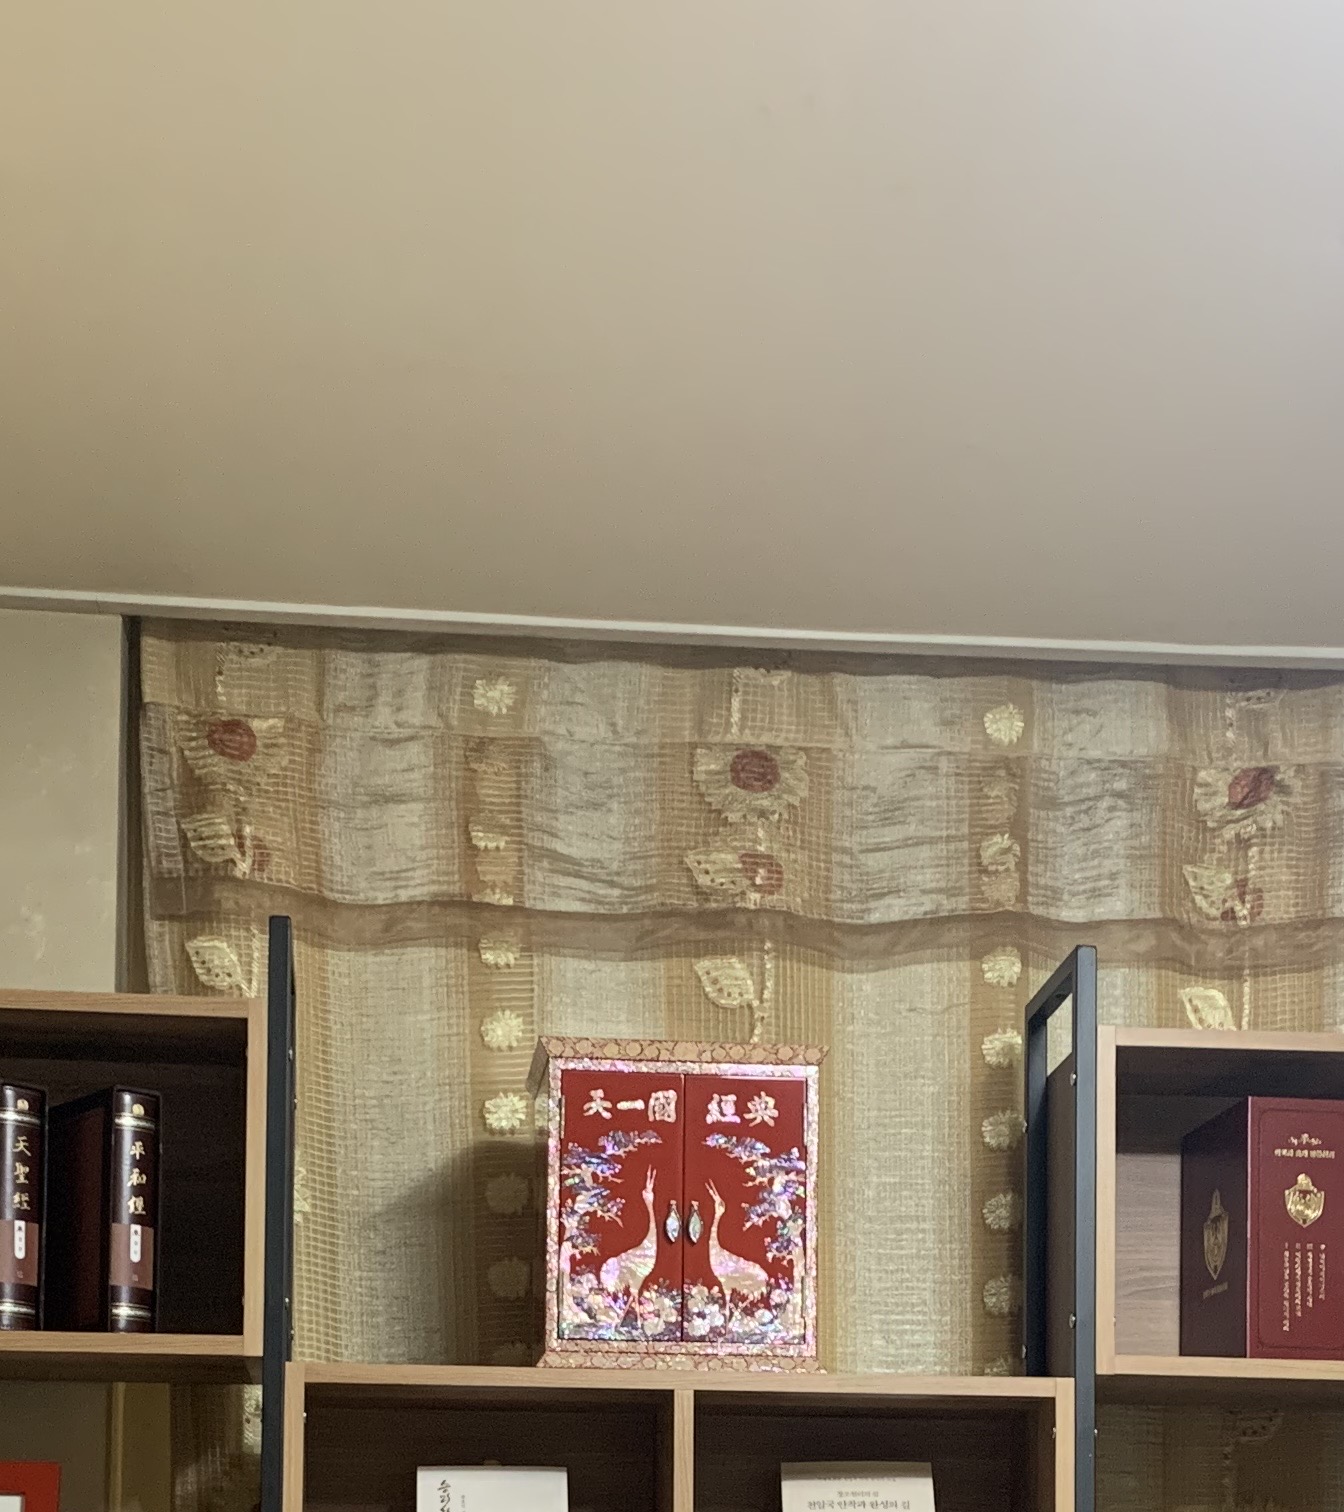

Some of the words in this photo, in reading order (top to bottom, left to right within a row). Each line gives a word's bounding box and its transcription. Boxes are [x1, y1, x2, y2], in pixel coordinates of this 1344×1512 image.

[583, 1088, 678, 1123] 天一國
[705, 1090, 780, 1128] 經典
[12, 1135, 32, 1211] 天聖經
[126, 1141, 148, 1216] 平和經
